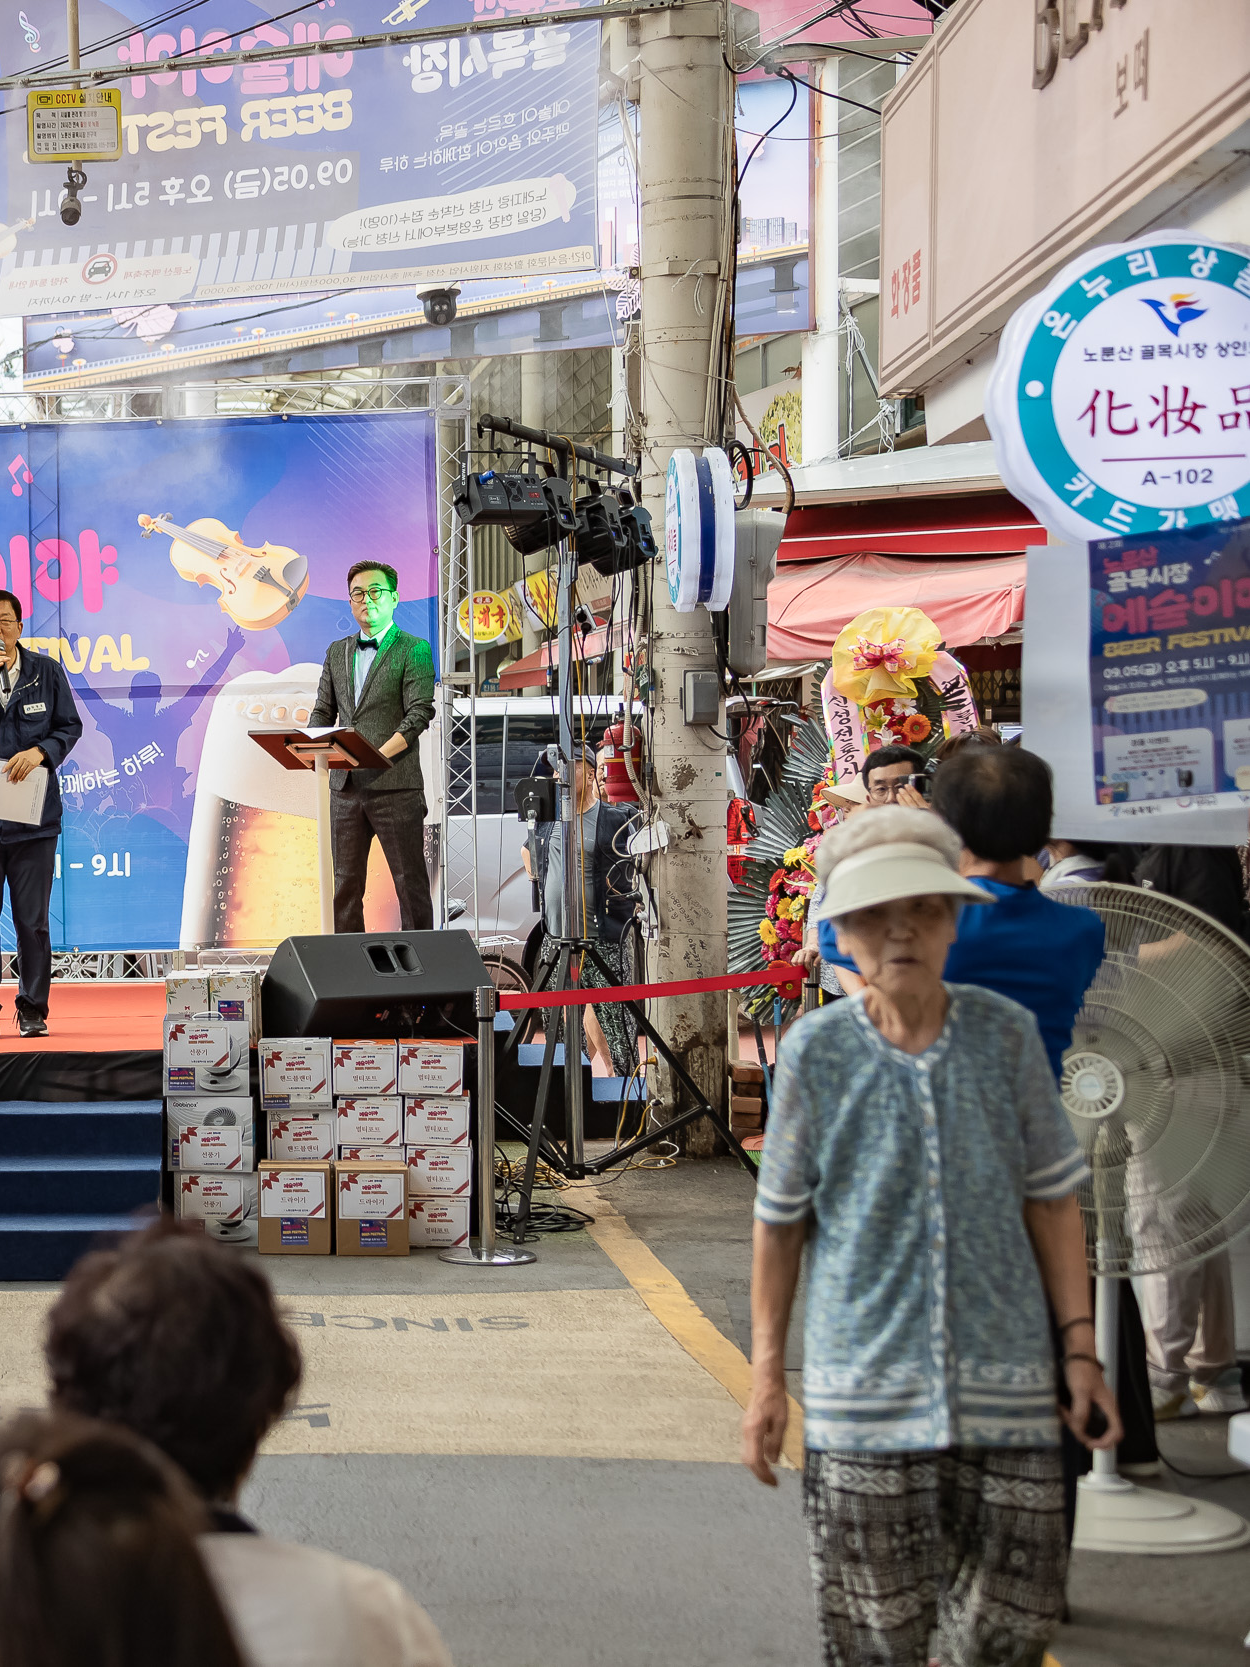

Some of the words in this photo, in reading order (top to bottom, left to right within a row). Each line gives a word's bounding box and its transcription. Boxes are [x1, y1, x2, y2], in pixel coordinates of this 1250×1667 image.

[56, 94, 76, 104] CCTV
[891, 248, 921, 319] 화장품
[1084, 346, 1133, 362] 노룬산
[1140, 342, 1207, 360] 골목시장
[1215, 340, 1250, 357] 상인
[1141, 468, 1213, 486] A-102
[1107, 562, 1193, 593] 골목시장
[1103, 637, 1161, 658] BEER
[120, 741, 165, 778] 하루!
[92, 853, 130, 877] 9시
